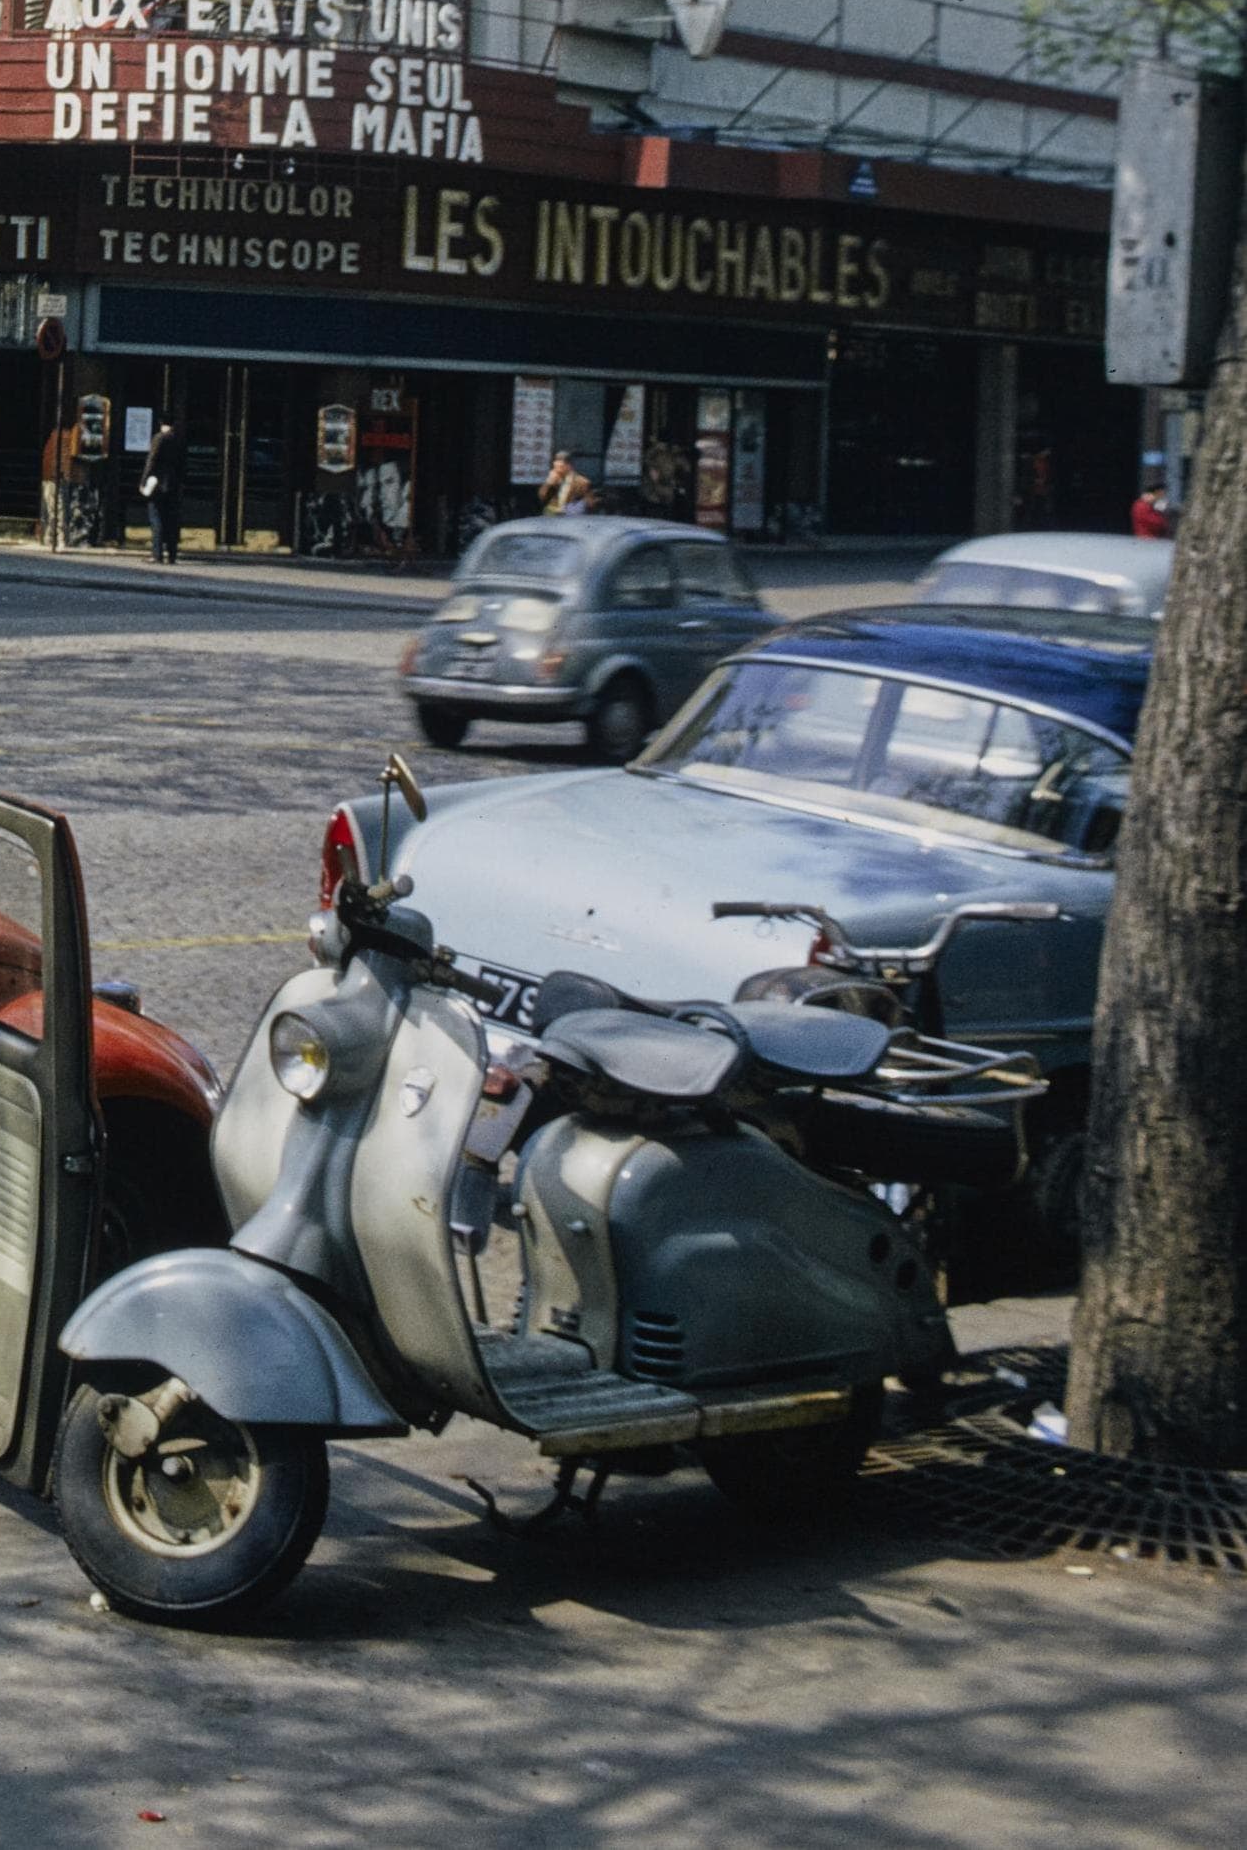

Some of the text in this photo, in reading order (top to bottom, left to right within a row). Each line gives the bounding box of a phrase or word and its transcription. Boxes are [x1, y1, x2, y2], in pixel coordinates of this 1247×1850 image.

[45, 42, 473, 112] UN HOMME SEUL
[53, 92, 484, 163] DEFIE LA MAFIA
[101, 174, 353, 218] TECHNICOLOR
[99, 230, 361, 275] TECHNISCOPE
[402, 184, 891, 308] LES INTOUCHABLES
